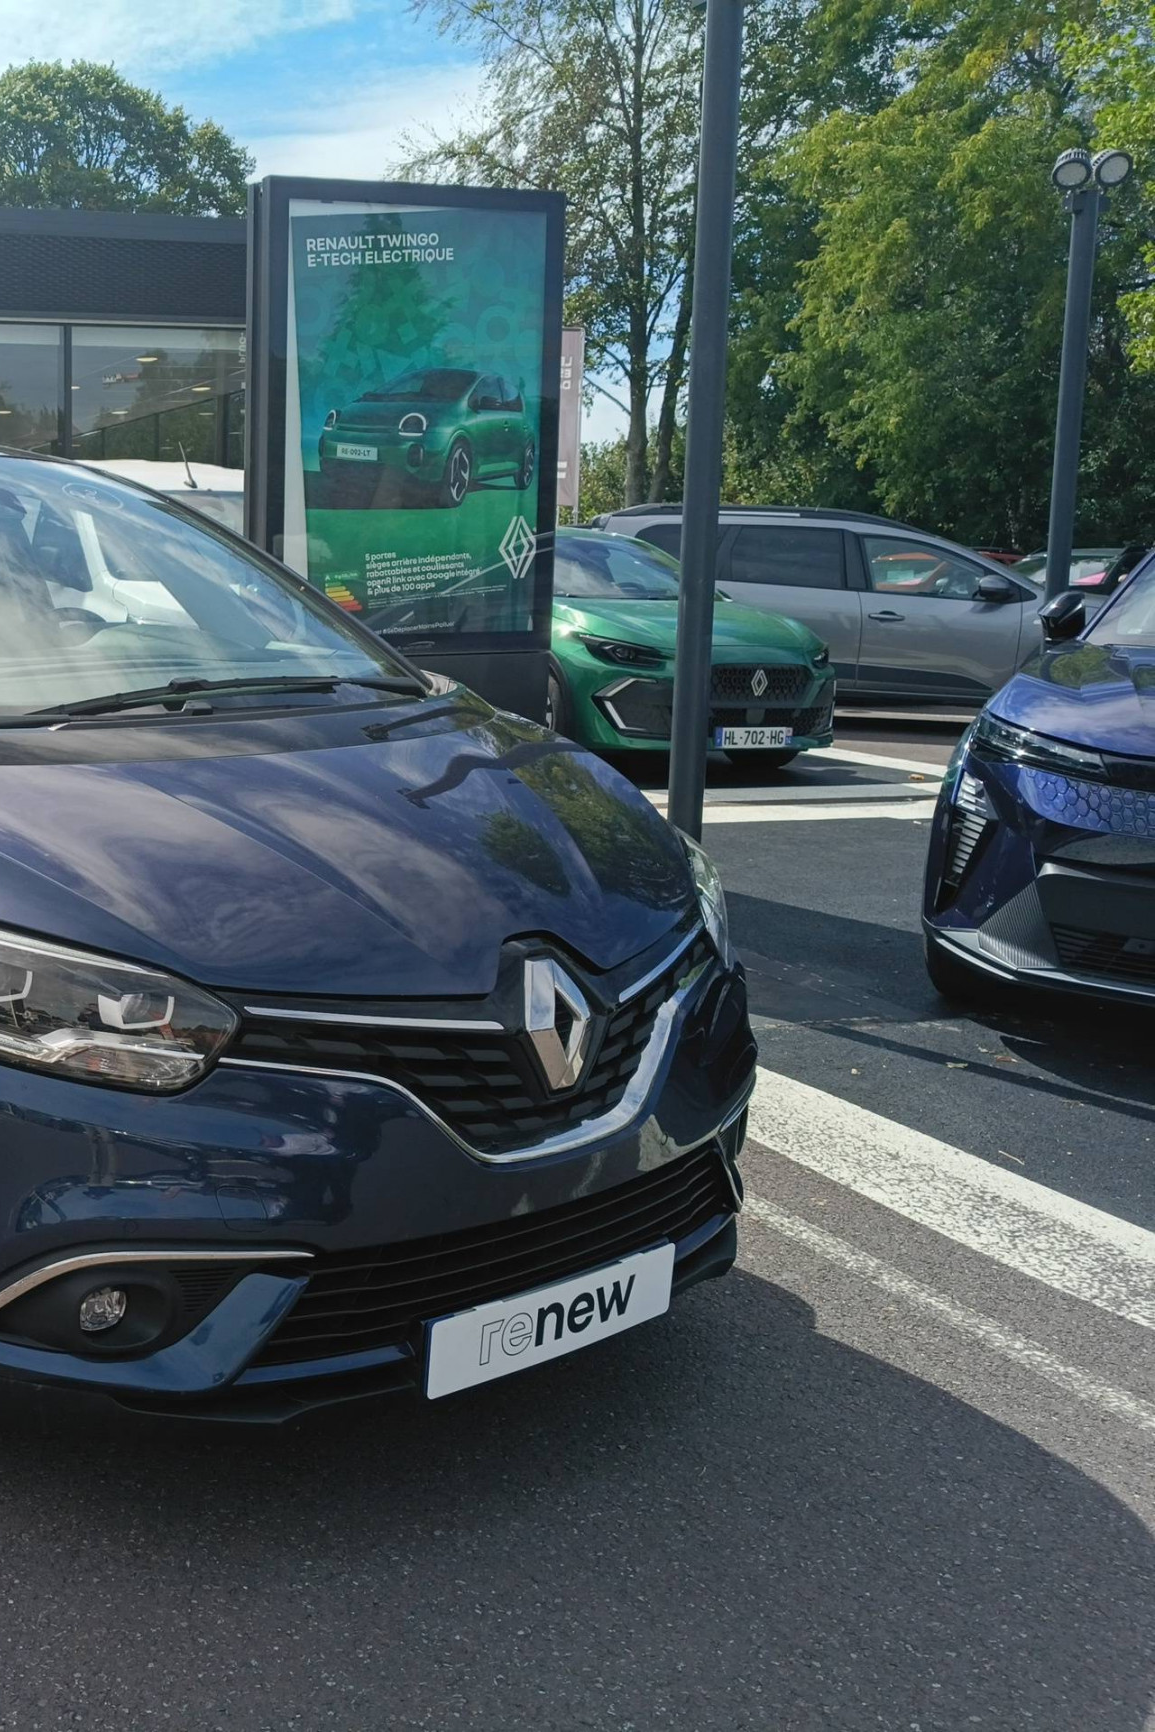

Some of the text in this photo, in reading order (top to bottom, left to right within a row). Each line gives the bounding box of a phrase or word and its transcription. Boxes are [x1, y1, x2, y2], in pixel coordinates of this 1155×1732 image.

[306, 233, 439, 251] RENAULT TWINGO
[307, 248, 454, 267] E-TECH ELECTRIQUE
[365, 552, 396, 561] 5 portes
[366, 567, 412, 578] rabattables
[366, 577, 392, 588] openR
[392, 576, 406, 584] link
[406, 574, 426, 582] avec
[426, 570, 455, 580] Google
[367, 582, 436, 596] & plus de 100 apps
[724, 730, 784, 745] HL-702-HG
[479, 1275, 636, 1366] renew
